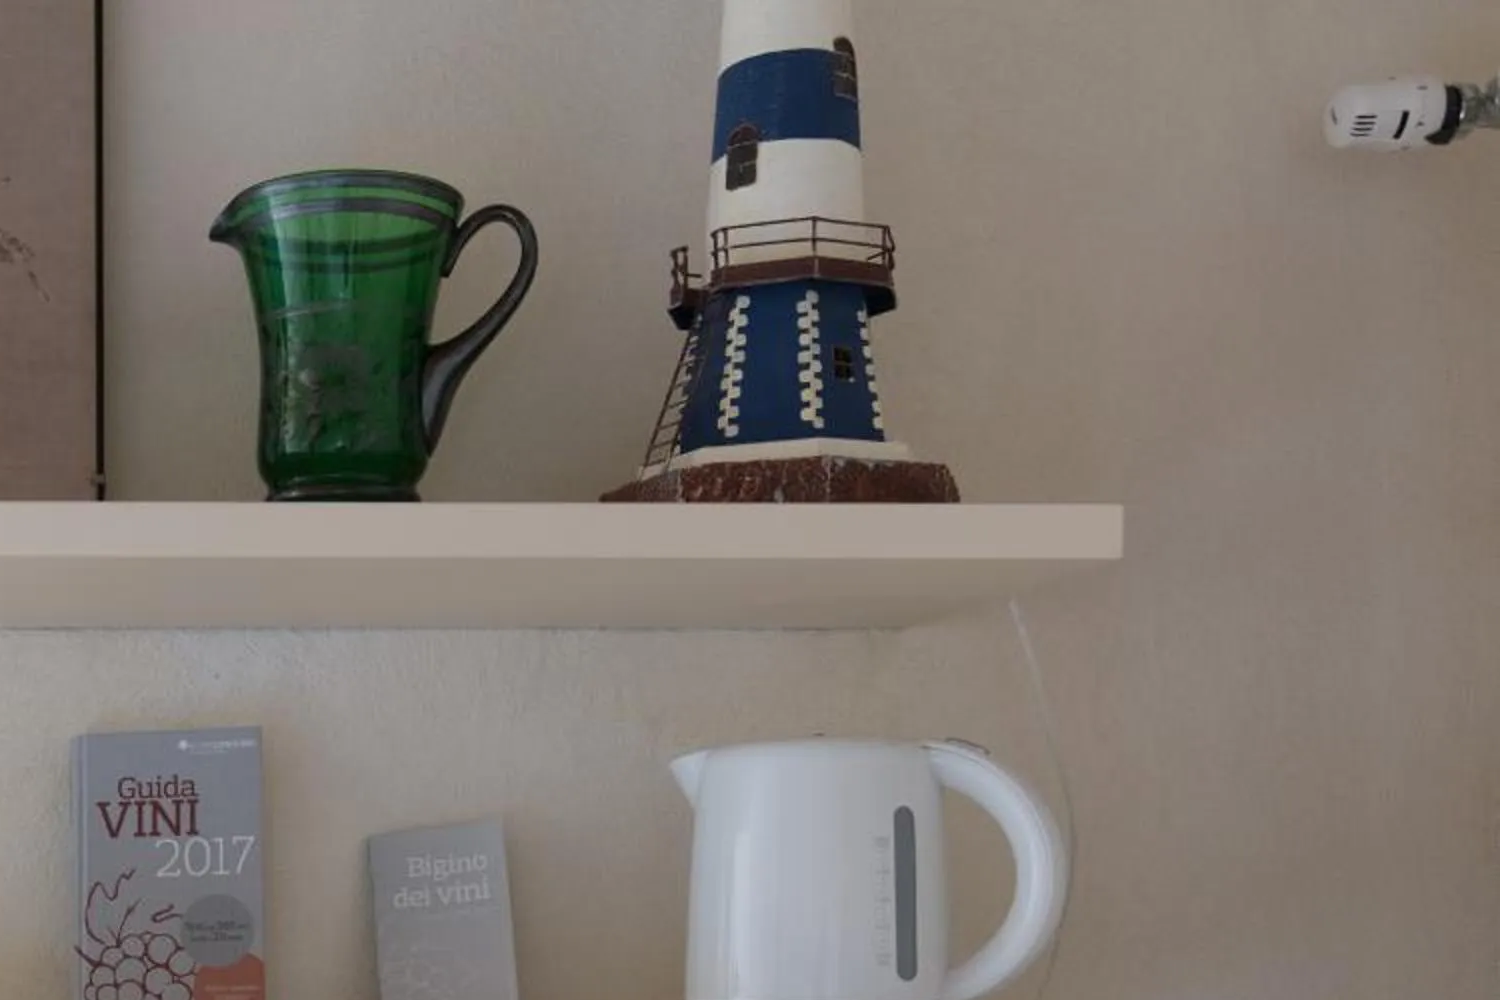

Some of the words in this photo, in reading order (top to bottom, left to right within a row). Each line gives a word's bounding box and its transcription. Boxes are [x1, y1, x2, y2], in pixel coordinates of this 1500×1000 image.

[117, 774, 199, 799] Guida
[96, 799, 200, 839] VINI
[155, 836, 255, 877] 2017
